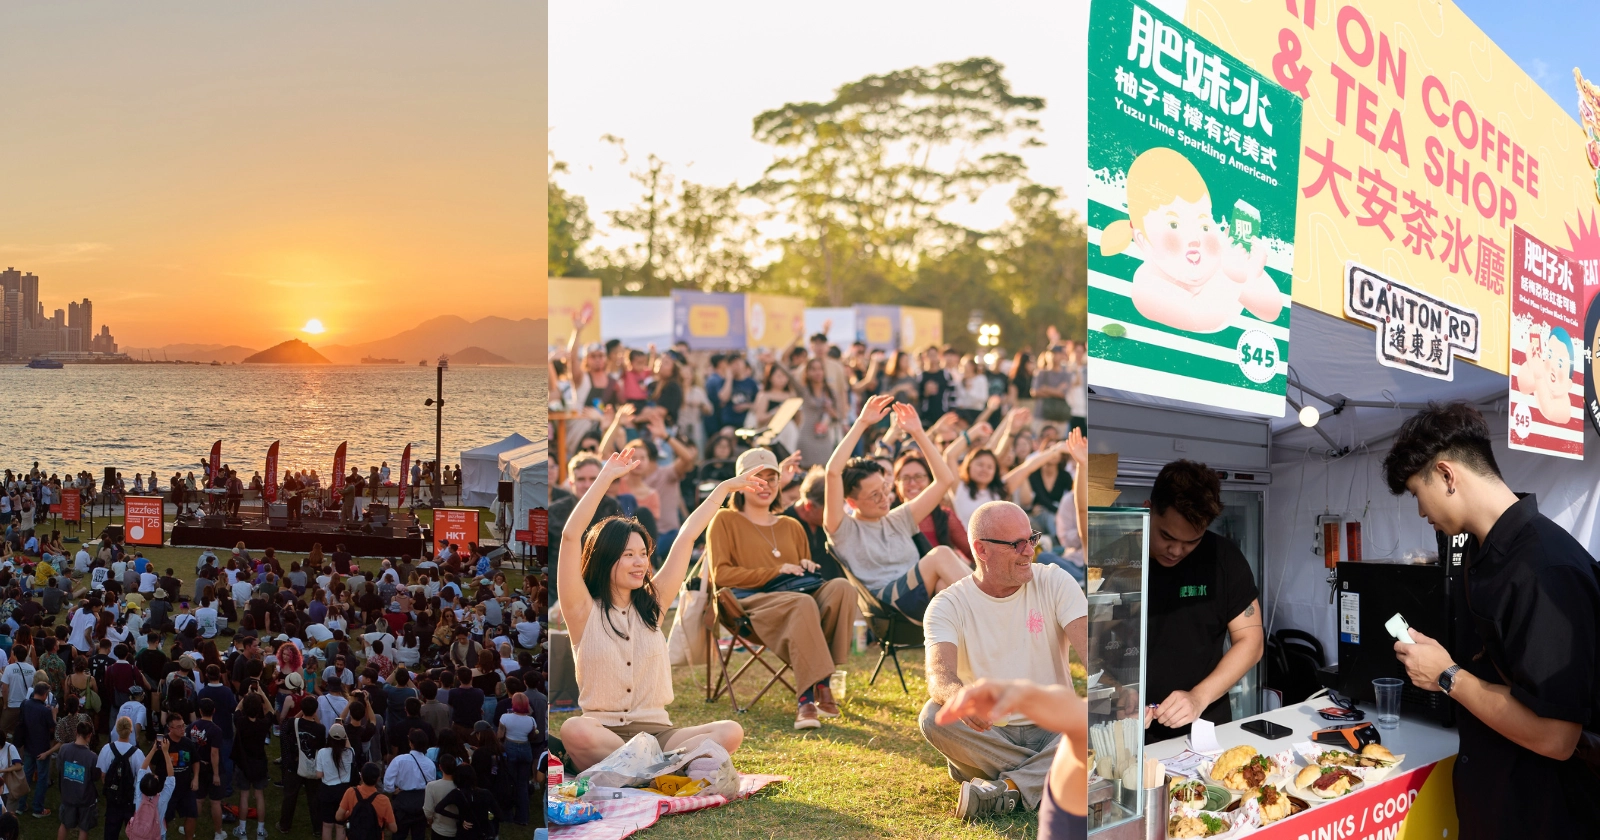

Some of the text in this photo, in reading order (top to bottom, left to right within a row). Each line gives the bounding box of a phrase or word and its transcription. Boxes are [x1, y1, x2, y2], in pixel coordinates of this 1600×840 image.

[1127, 4, 1273, 137] 肥妹水
[1114, 65, 1278, 171] 柚子青檸有汽美式
[1337, 5, 1539, 199] ON COFFEE
[1114, 97, 1278, 187] Yuzu Lime Sparkling Americano
[1272, 28, 1517, 229] & TEA SHOP
[1235, 218, 1252, 242] 肥
[1524, 237, 1574, 293] 肥仔水
[1579, 259, 1599, 286] EAT
[1360, 279, 1442, 334] CANTON
[1241, 343, 1275, 368] $45
[1515, 412, 1530, 428] $45
[128, 505, 160, 515] jazzfest
[147, 518, 160, 528] 25
[445, 531, 466, 540] HKT
